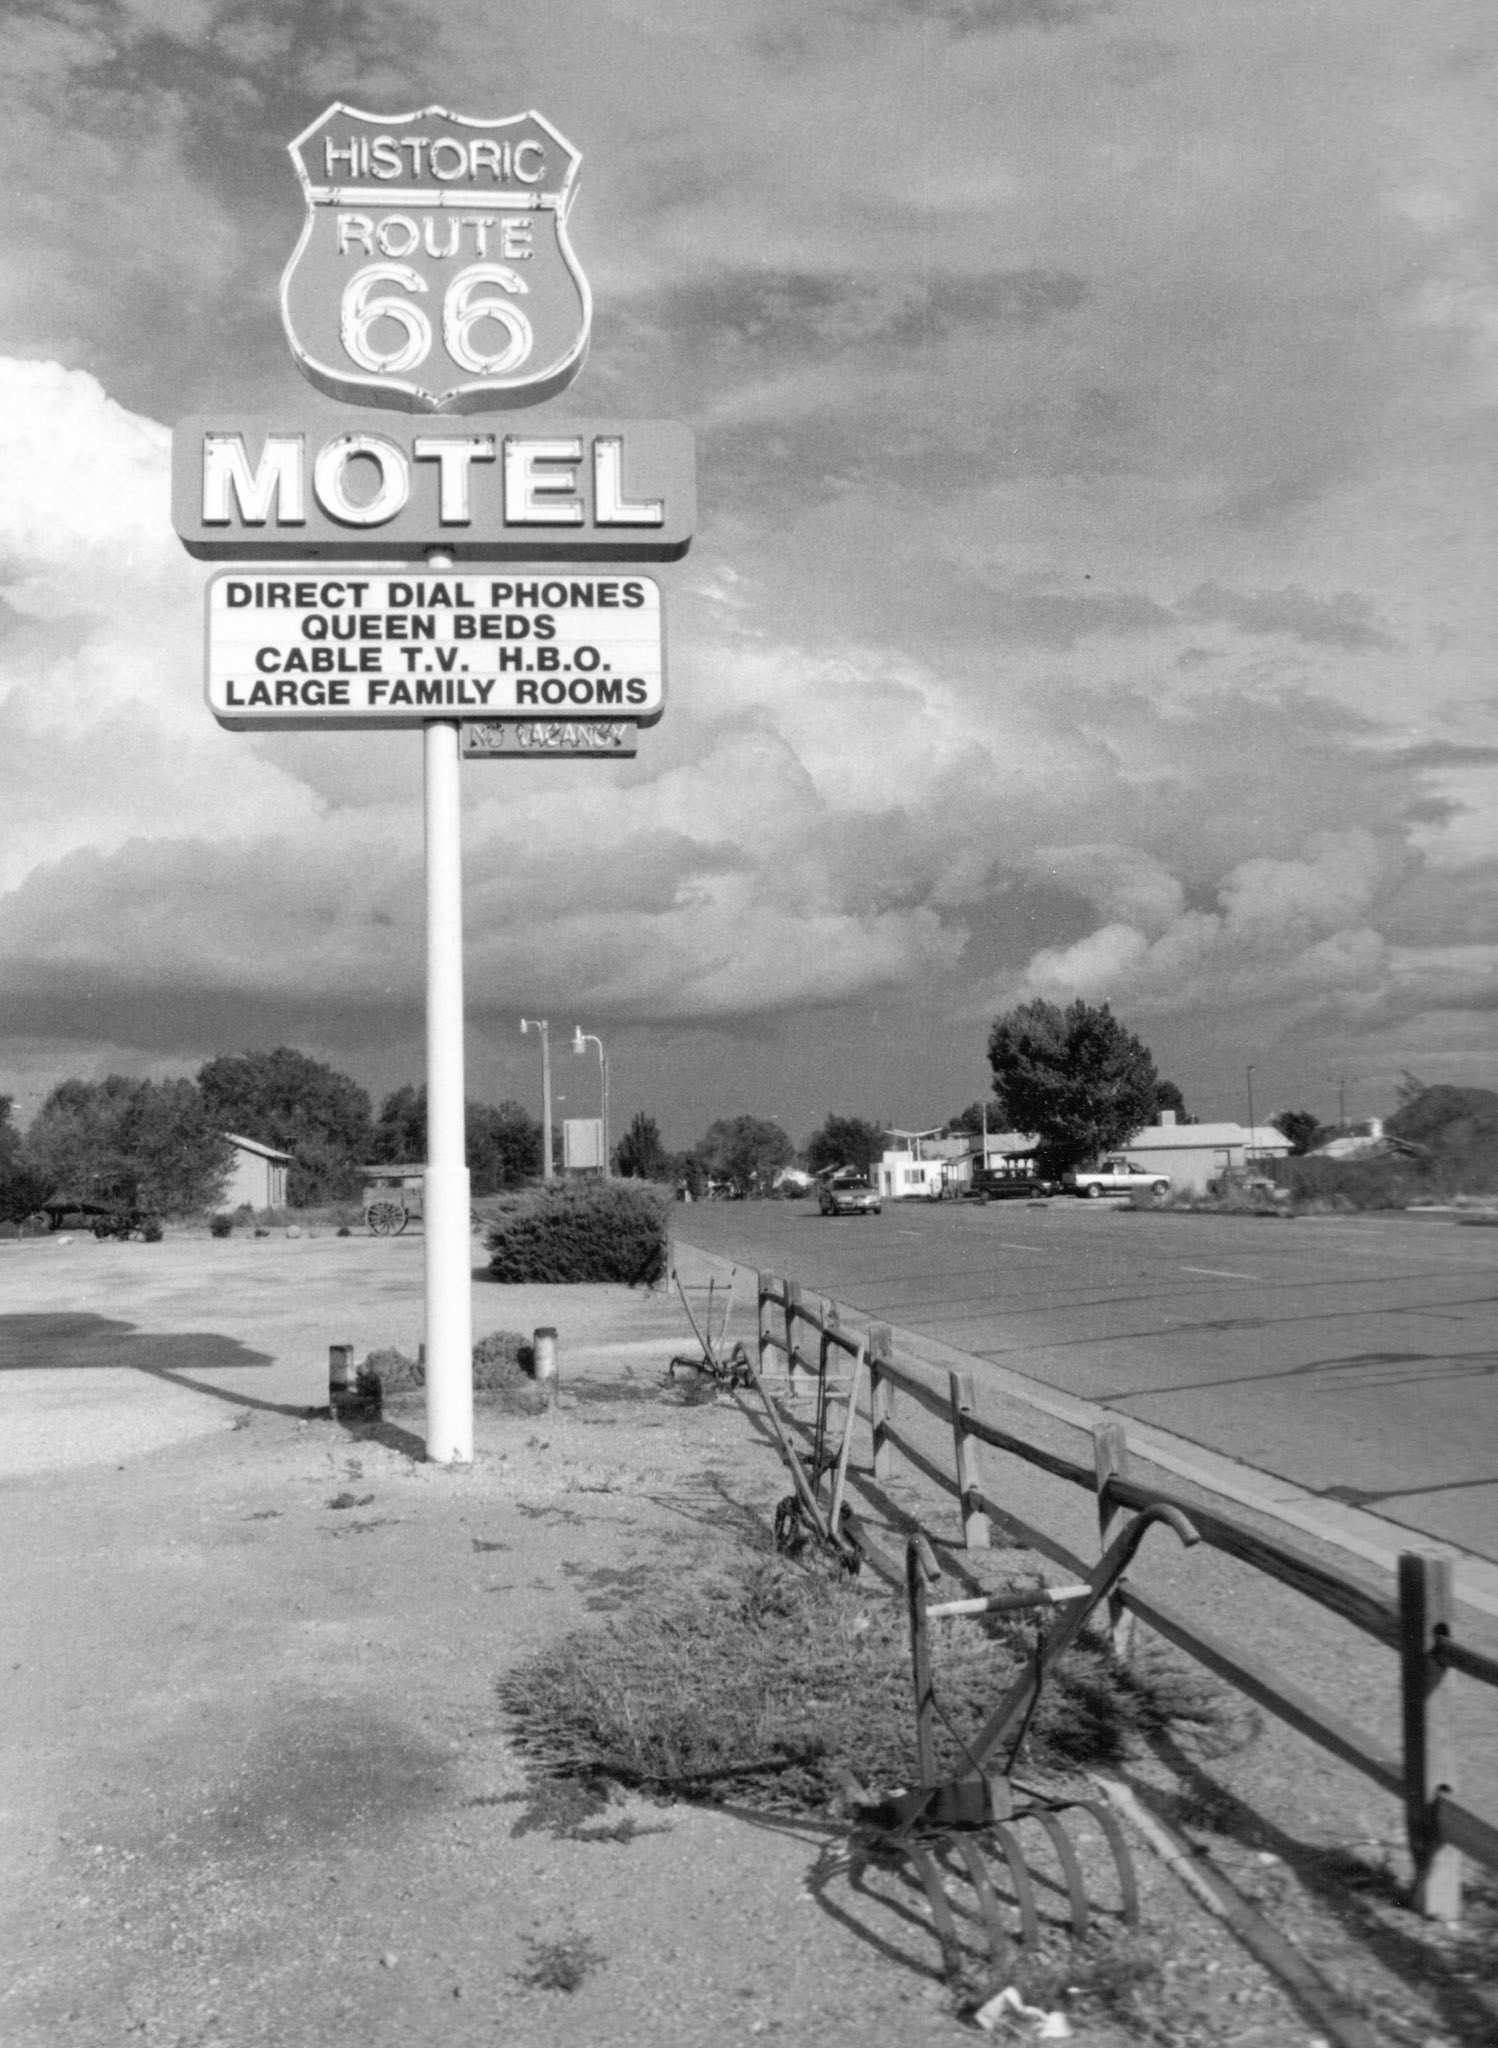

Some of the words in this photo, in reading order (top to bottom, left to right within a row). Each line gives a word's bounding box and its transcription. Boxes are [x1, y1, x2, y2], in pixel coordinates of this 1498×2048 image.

[324, 136, 546, 183] HISTORIC
[337, 213, 534, 259] ROUTE
[340, 262, 534, 374] 66
[202, 431, 665, 529] MOTEL
[226, 582, 369, 608] DIRECT
[388, 582, 475, 608] DIAL
[491, 582, 645, 608] PHONES
[301, 614, 436, 641] QUEEN
[453, 614, 556, 640] BEDS
[255, 646, 382, 673] CABLE
[401, 647, 469, 672] T.V.
[499, 646, 611, 672] H.B.O.
[226, 680, 350, 706] LARGE
[368, 680, 496, 706] FAMILY
[515, 679, 648, 704] ROOMS
[470, 723, 504, 748] NO
[516, 722, 627, 748] VACANCY
